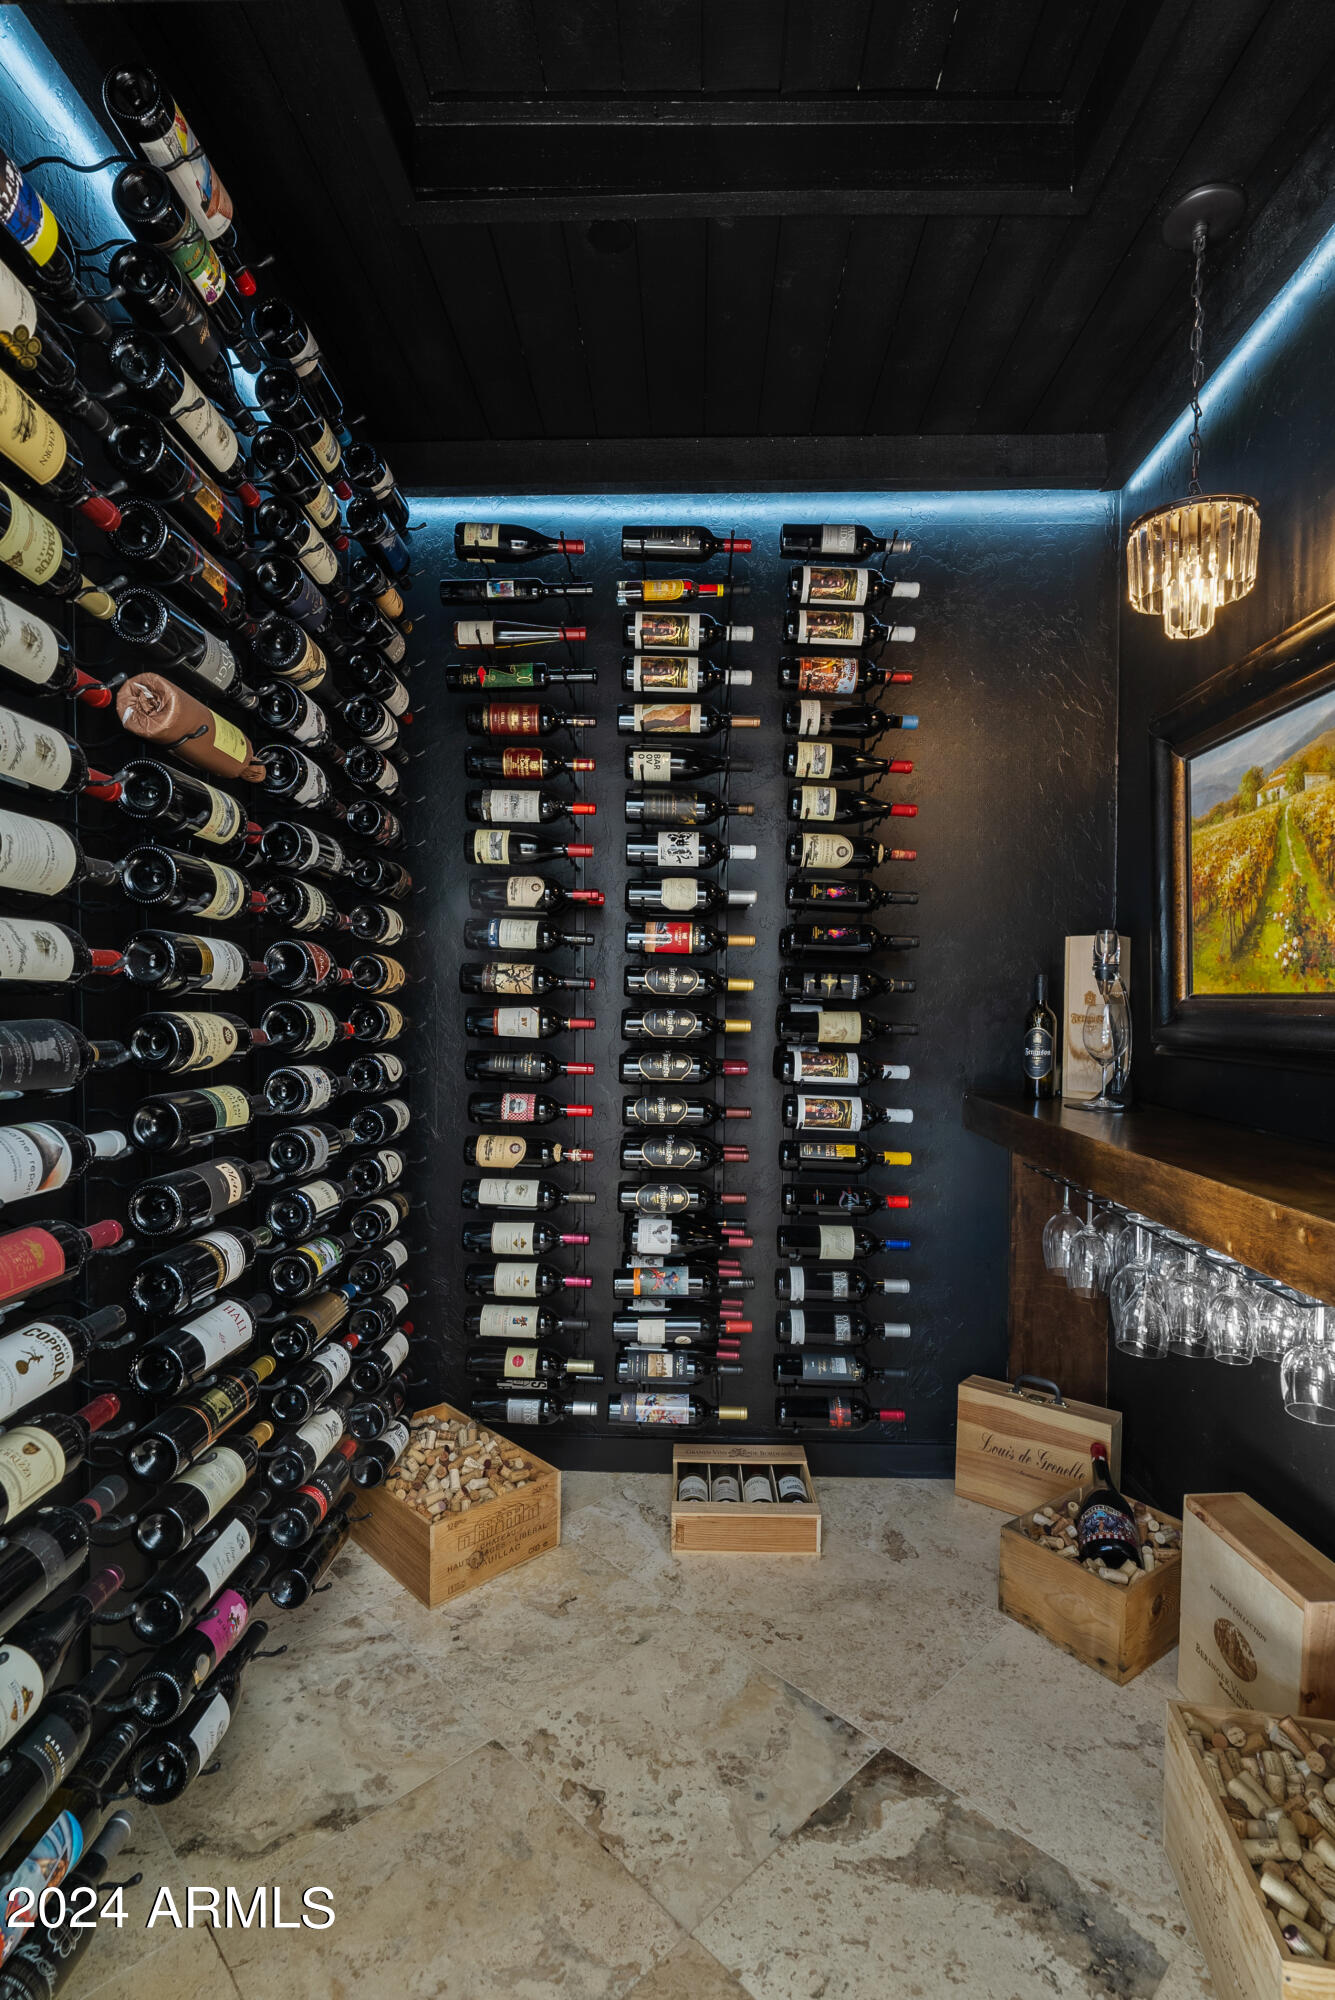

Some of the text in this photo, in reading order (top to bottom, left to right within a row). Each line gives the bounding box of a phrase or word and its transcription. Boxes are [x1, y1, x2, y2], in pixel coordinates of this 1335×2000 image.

[34, 520, 56, 575] TEMPUS
[644, 753, 653, 765] OV
[652, 753, 661, 770] BAR
[520, 1016, 528, 1027] BV
[1024, 1047, 1051, 1057] Ferguson
[832, 1271, 842, 1297] RIDGE
[223, 1305, 247, 1336] HALL
[22, 1327, 66, 1387] COPPOLA
[979, 1431, 1015, 1460] Louis
[1018, 1448, 1032, 1465] de
[1036, 1449, 1087, 1481] Grenelle
[316, 1478, 333, 1501] eleven
[480, 1531, 517, 1550] CHATEAU
[447, 1560, 464, 1574] HAU
[1232, 1606, 1267, 1643] COLLECTION
[1195, 1642, 1230, 1687] BERINGER
